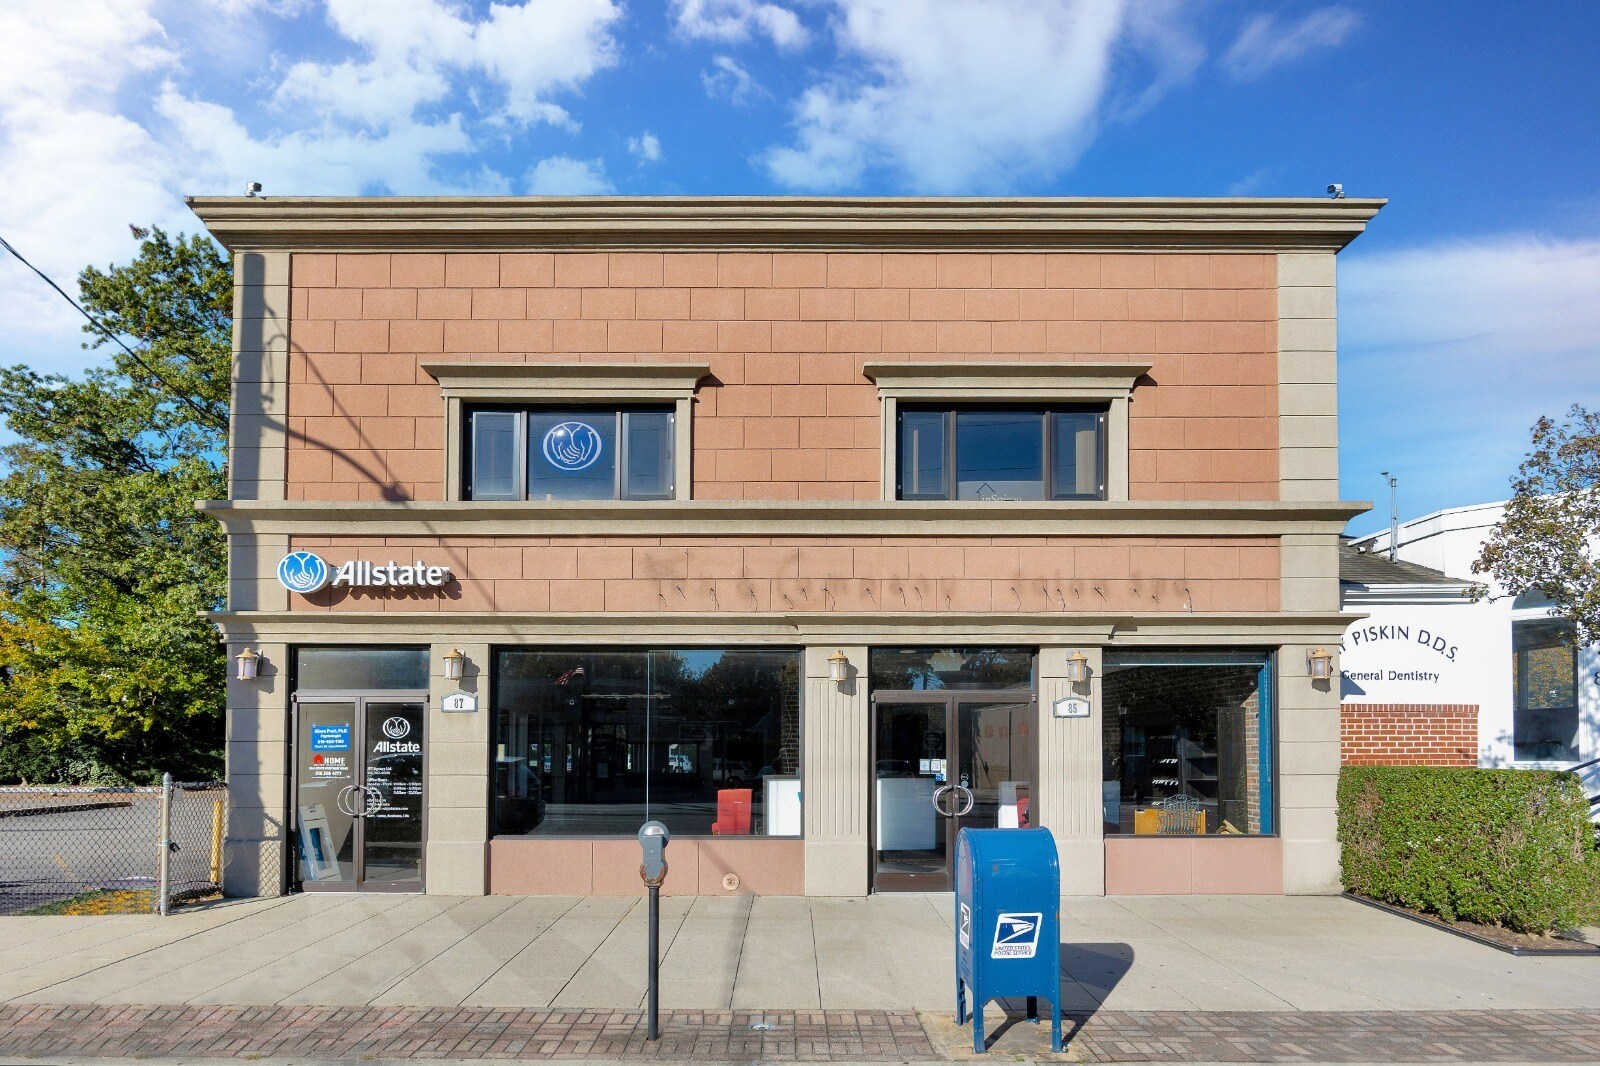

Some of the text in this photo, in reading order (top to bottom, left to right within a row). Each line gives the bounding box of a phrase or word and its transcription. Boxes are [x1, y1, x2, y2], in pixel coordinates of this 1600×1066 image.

[332, 560, 442, 586] Allstate
[1352, 625, 1409, 645] PISKIN
[1417, 630, 1458, 662] D.D.S.
[1341, 670, 1440, 683] General Dentistry
[454, 698, 463, 708] 87
[1068, 703, 1077, 713] 85
[373, 741, 420, 752] Allstate
